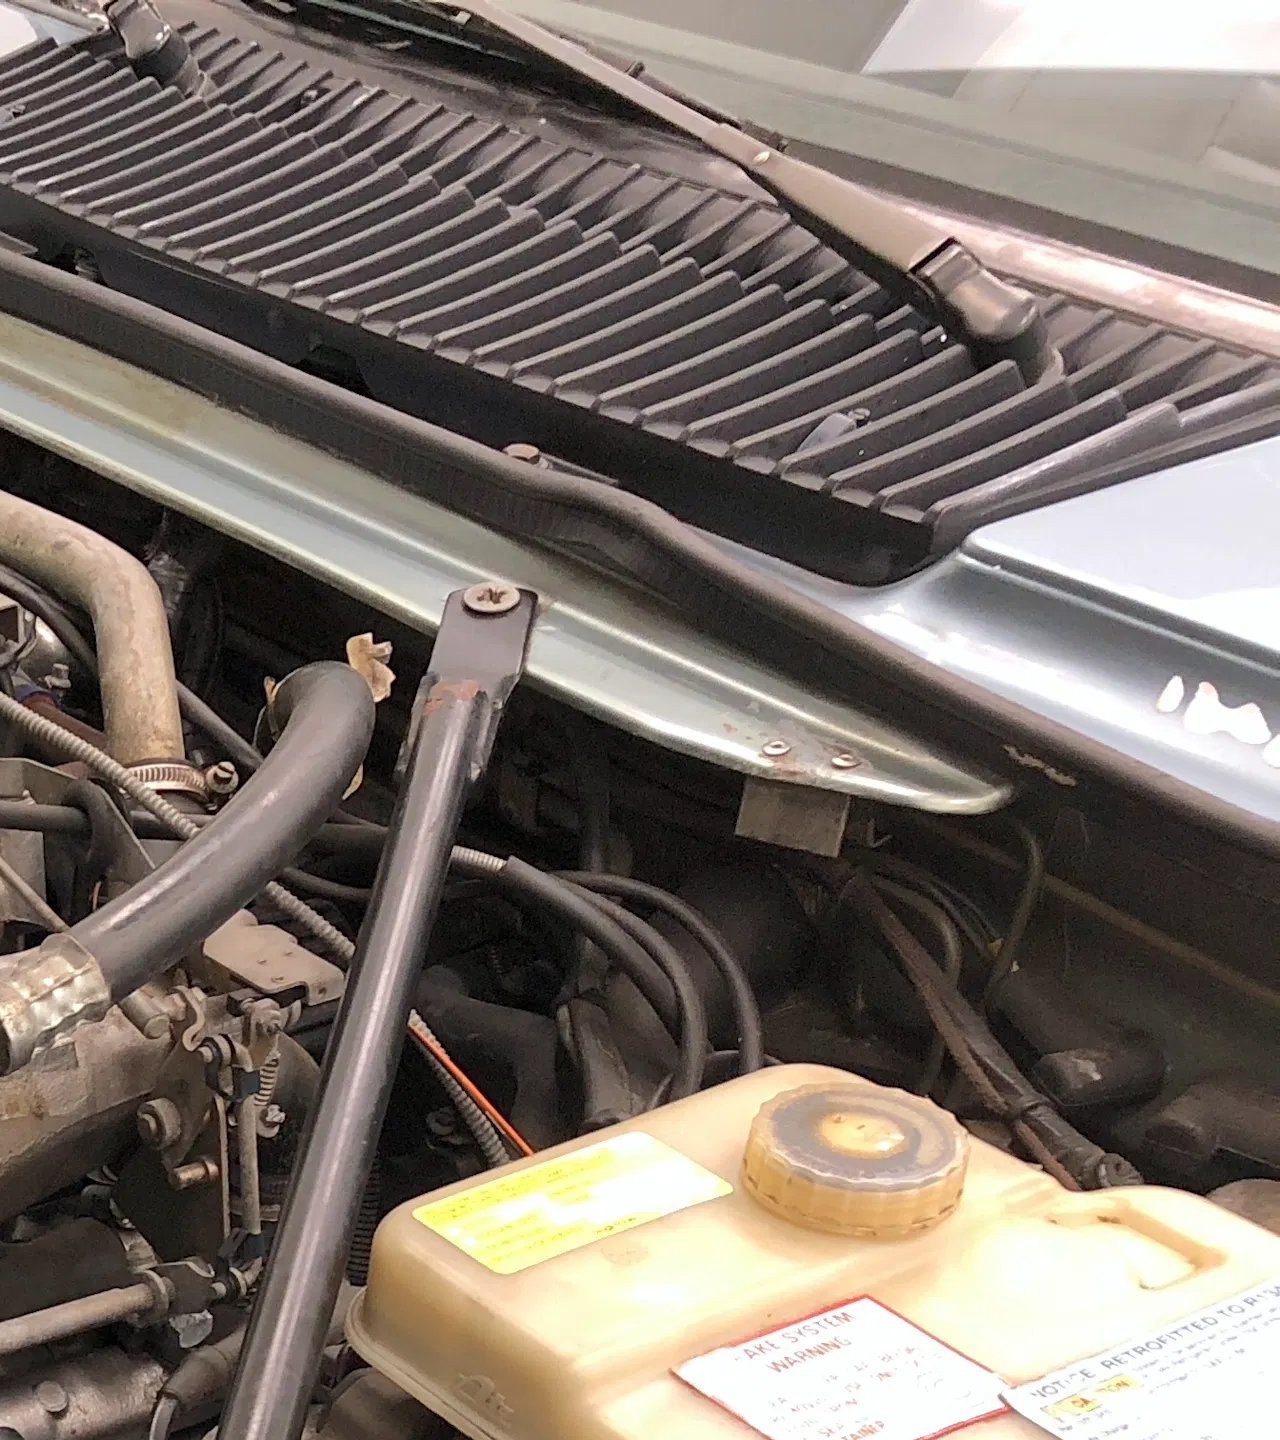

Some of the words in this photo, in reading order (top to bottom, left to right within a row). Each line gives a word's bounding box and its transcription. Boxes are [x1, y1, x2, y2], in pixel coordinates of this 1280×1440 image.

[781, 1311, 855, 1344] SYSTEM
[1099, 1316, 1219, 1370] RETROFITTED
[1216, 1303, 1246, 1319] TO
[764, 1335, 853, 1374] WARNING
